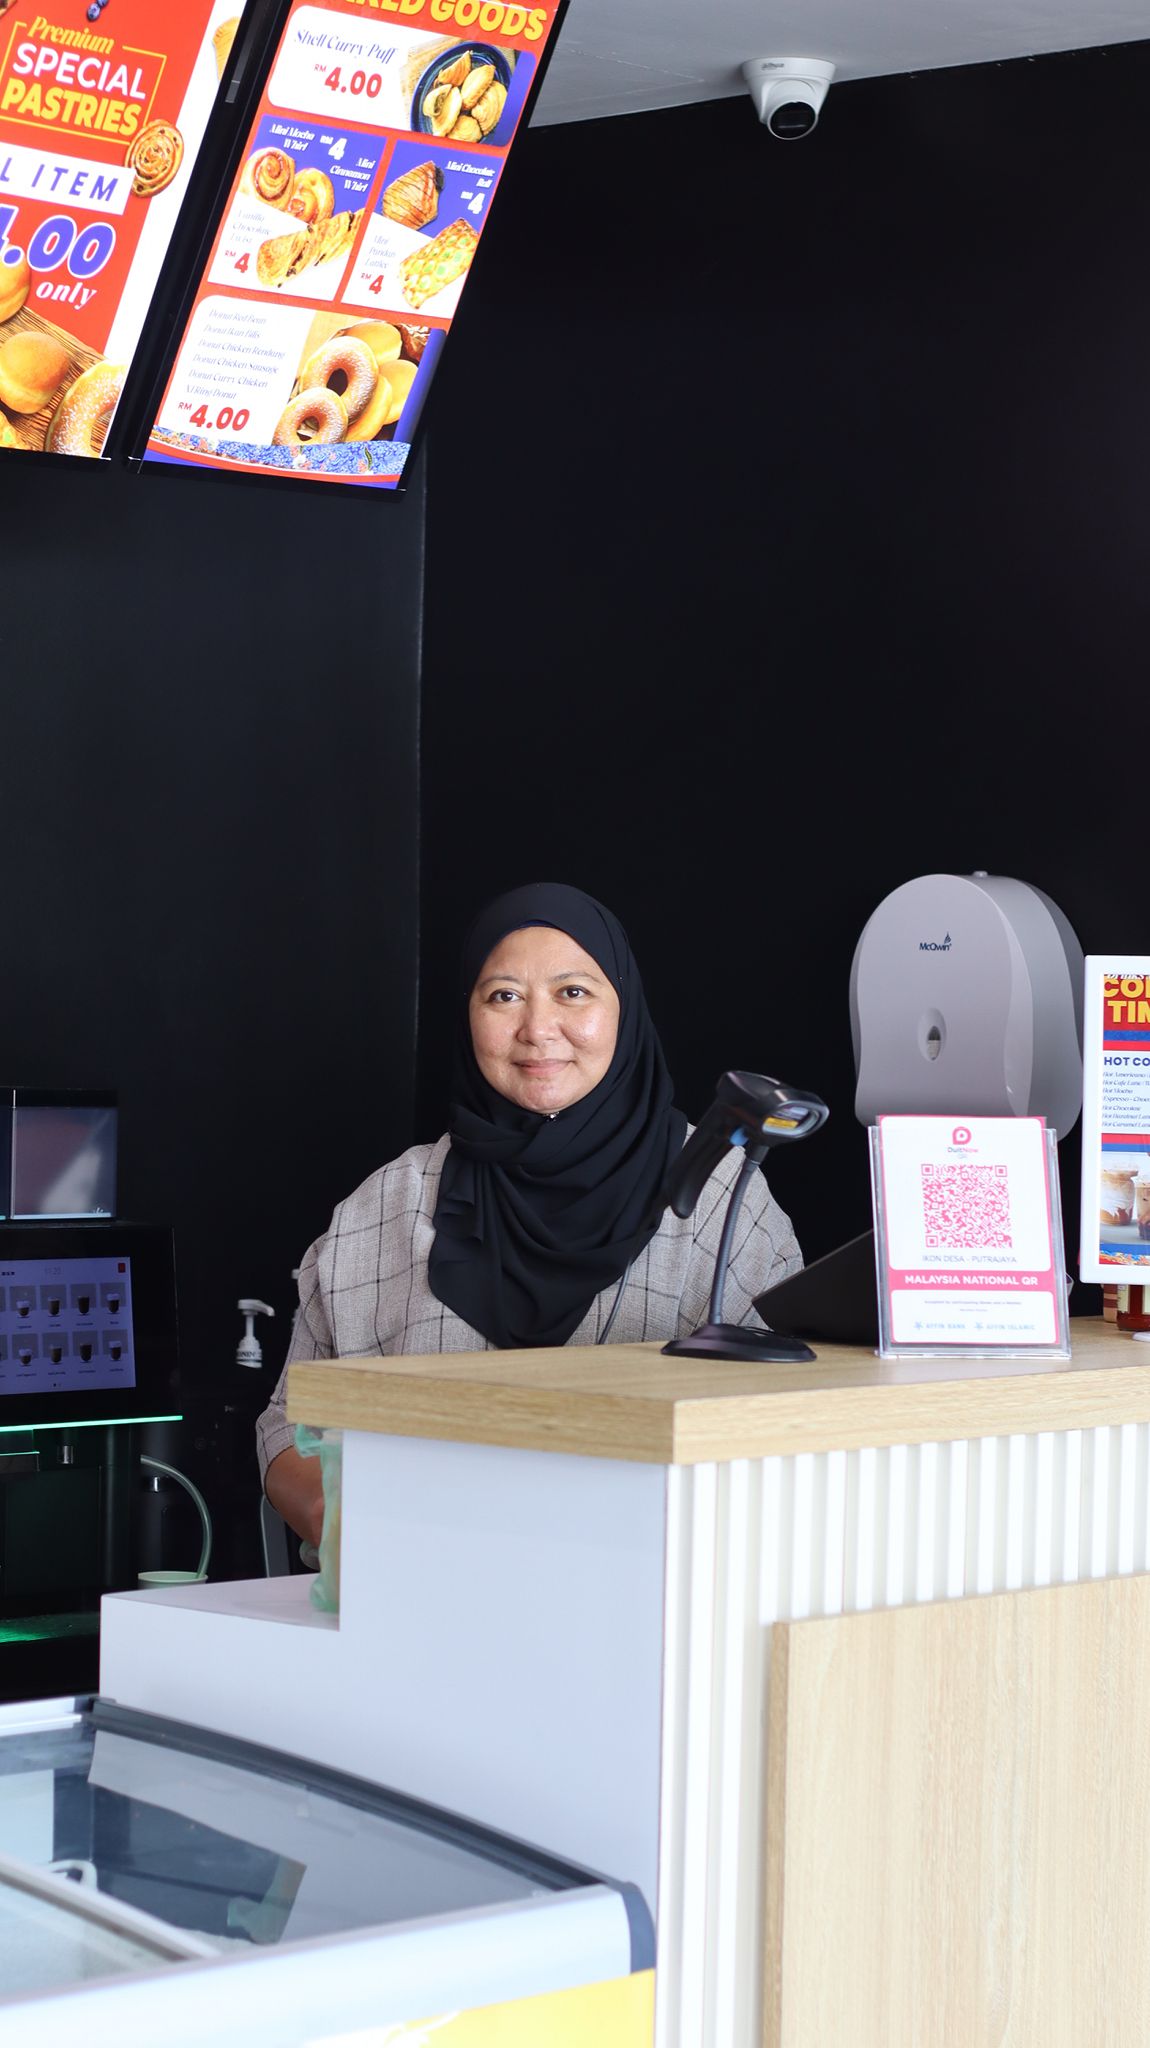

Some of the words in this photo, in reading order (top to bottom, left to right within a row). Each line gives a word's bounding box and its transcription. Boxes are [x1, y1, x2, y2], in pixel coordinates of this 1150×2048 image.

[28, 16, 115, 55] Premium
[294, 29, 326, 48] Shell
[327, 37, 364, 58] Curry
[366, 42, 400, 65] Puff
[13, 43, 146, 100] SPECIAL
[314, 63, 327, 74] RM
[325, 67, 383, 98] 4.00
[1, 77, 142, 136] PASTRIES
[328, 138, 348, 161] 4
[31, 164, 119, 202] ITEM
[467, 192, 486, 214] 4
[234, 252, 250, 274] 4
[36, 281, 97, 310] only
[368, 274, 384, 294] 4
[178, 402, 192, 411] RM
[189, 404, 250, 432] 4.00
[1104, 1057, 1130, 1066] HOT
[972, 1256, 1017, 1264] PUTRAJAYA
[904, 1275, 960, 1285] MALAYSIA
[963, 1276, 1020, 1286] NATIONAL
[1021, 1276, 1038, 1286] QR
